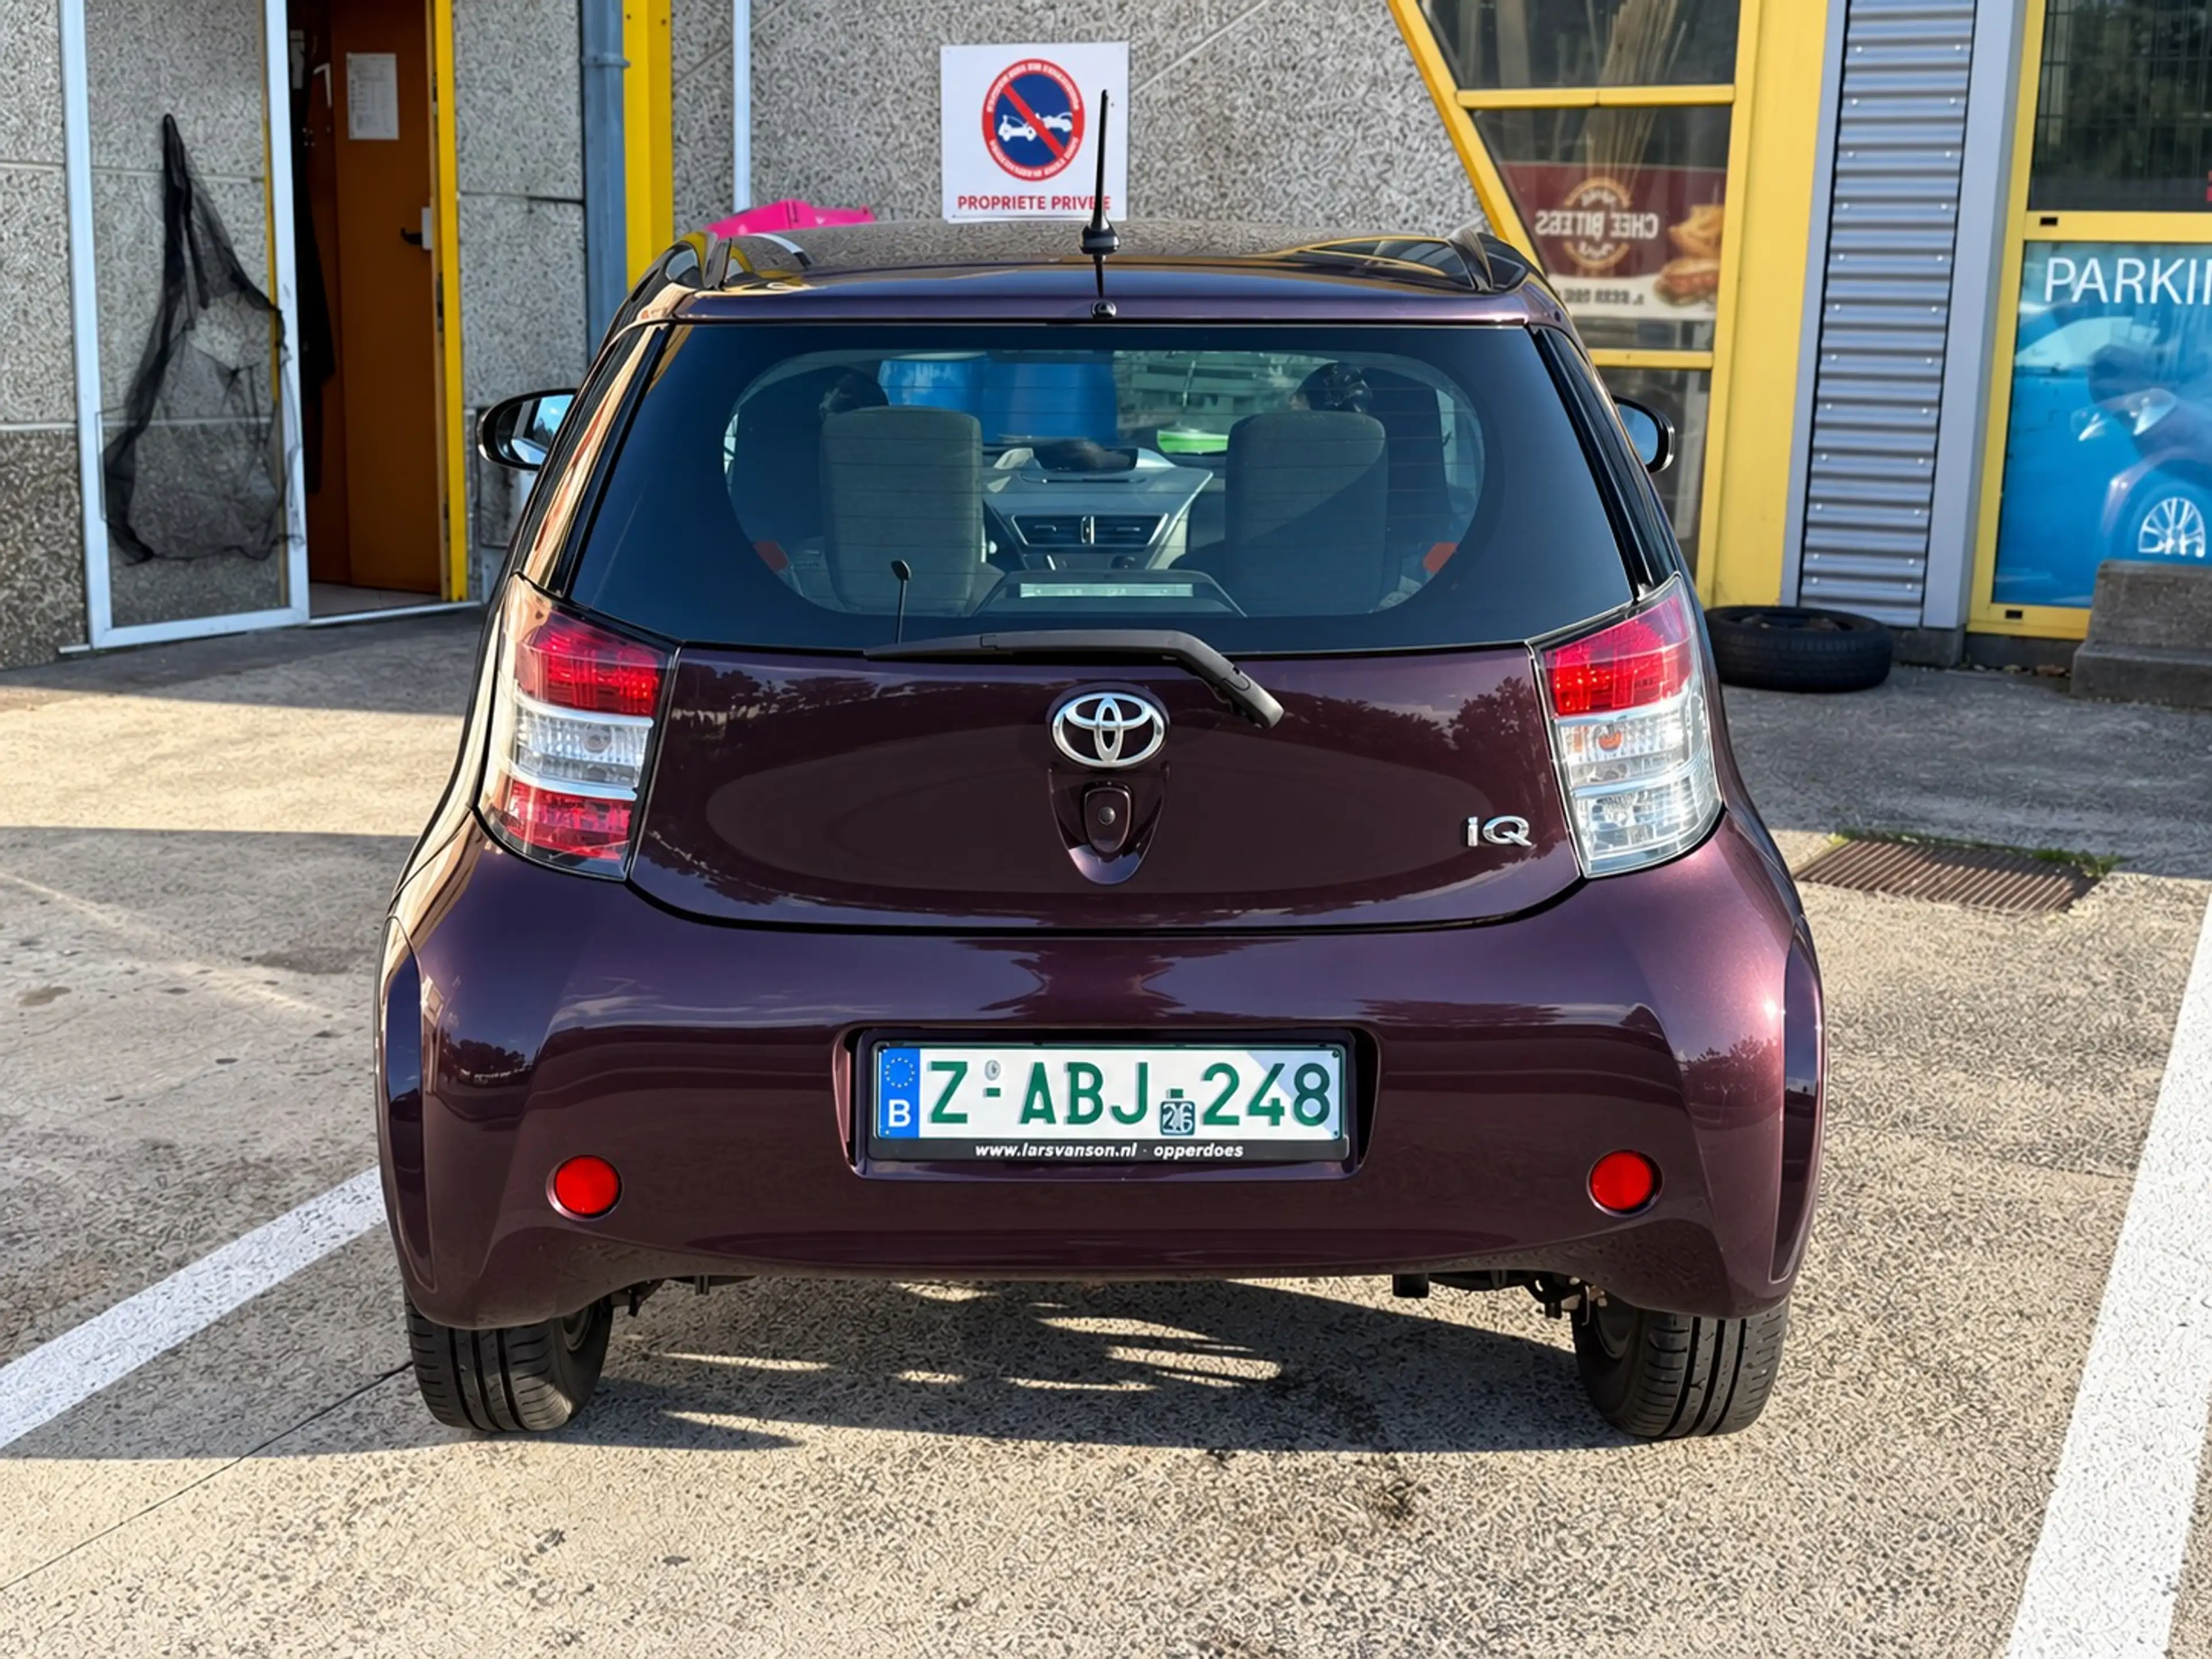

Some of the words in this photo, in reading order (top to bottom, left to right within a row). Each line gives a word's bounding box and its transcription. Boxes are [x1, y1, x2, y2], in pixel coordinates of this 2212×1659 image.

[957, 195, 1046, 210] PROPRIETE
[2045, 256, 2212, 305] PARKI
[1468, 815, 1533, 846] iQ
[888, 1099, 911, 1127] B
[975, 1142, 1137, 1158] www.larsvanson.nl
[1153, 1143, 1244, 1160] opperdoes
